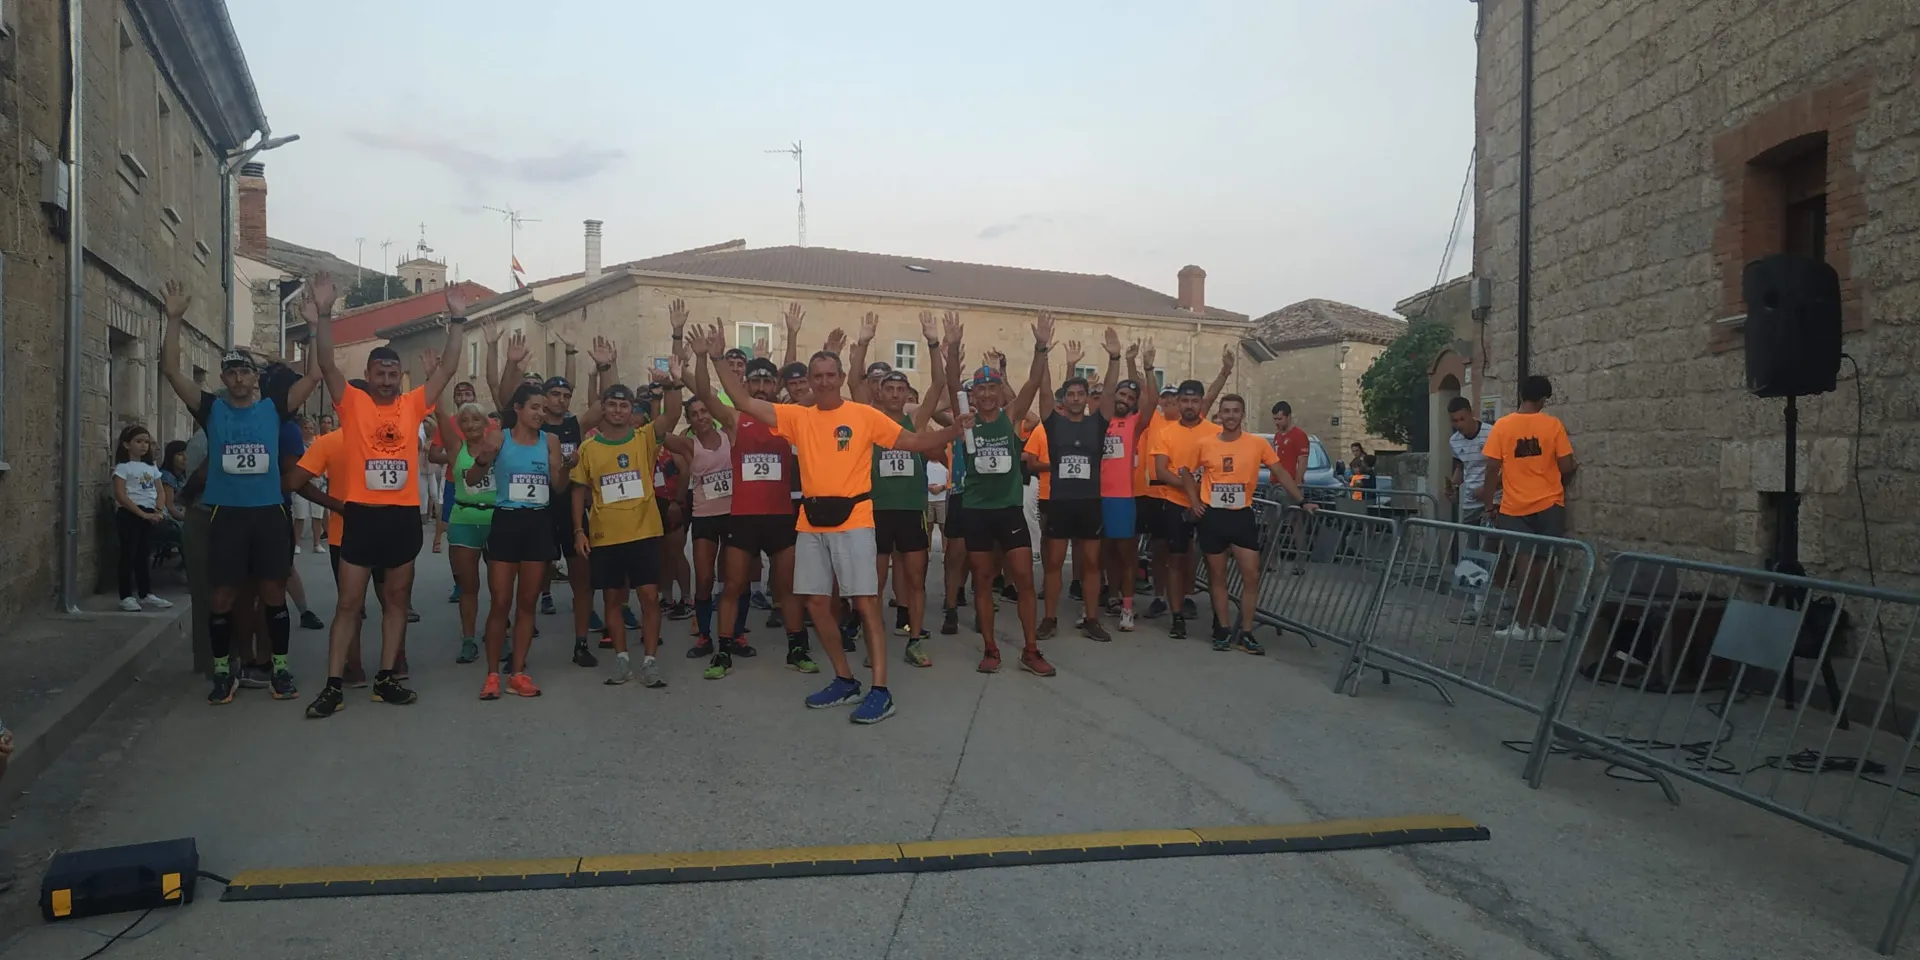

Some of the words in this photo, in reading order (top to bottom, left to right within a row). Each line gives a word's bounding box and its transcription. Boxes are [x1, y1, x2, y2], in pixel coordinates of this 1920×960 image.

[1101, 445, 1114, 454] 23
[236, 454, 256, 468] 28
[890, 459, 905, 471] 18
[989, 456, 997, 468] 3
[754, 463, 770, 475] 29
[1067, 463, 1081, 474] 26
[380, 471, 398, 484] 13
[527, 485, 536, 497] 2
[617, 483, 625, 495] 1
[714, 480, 729, 492] 48
[1220, 492, 1235, 503] 45
